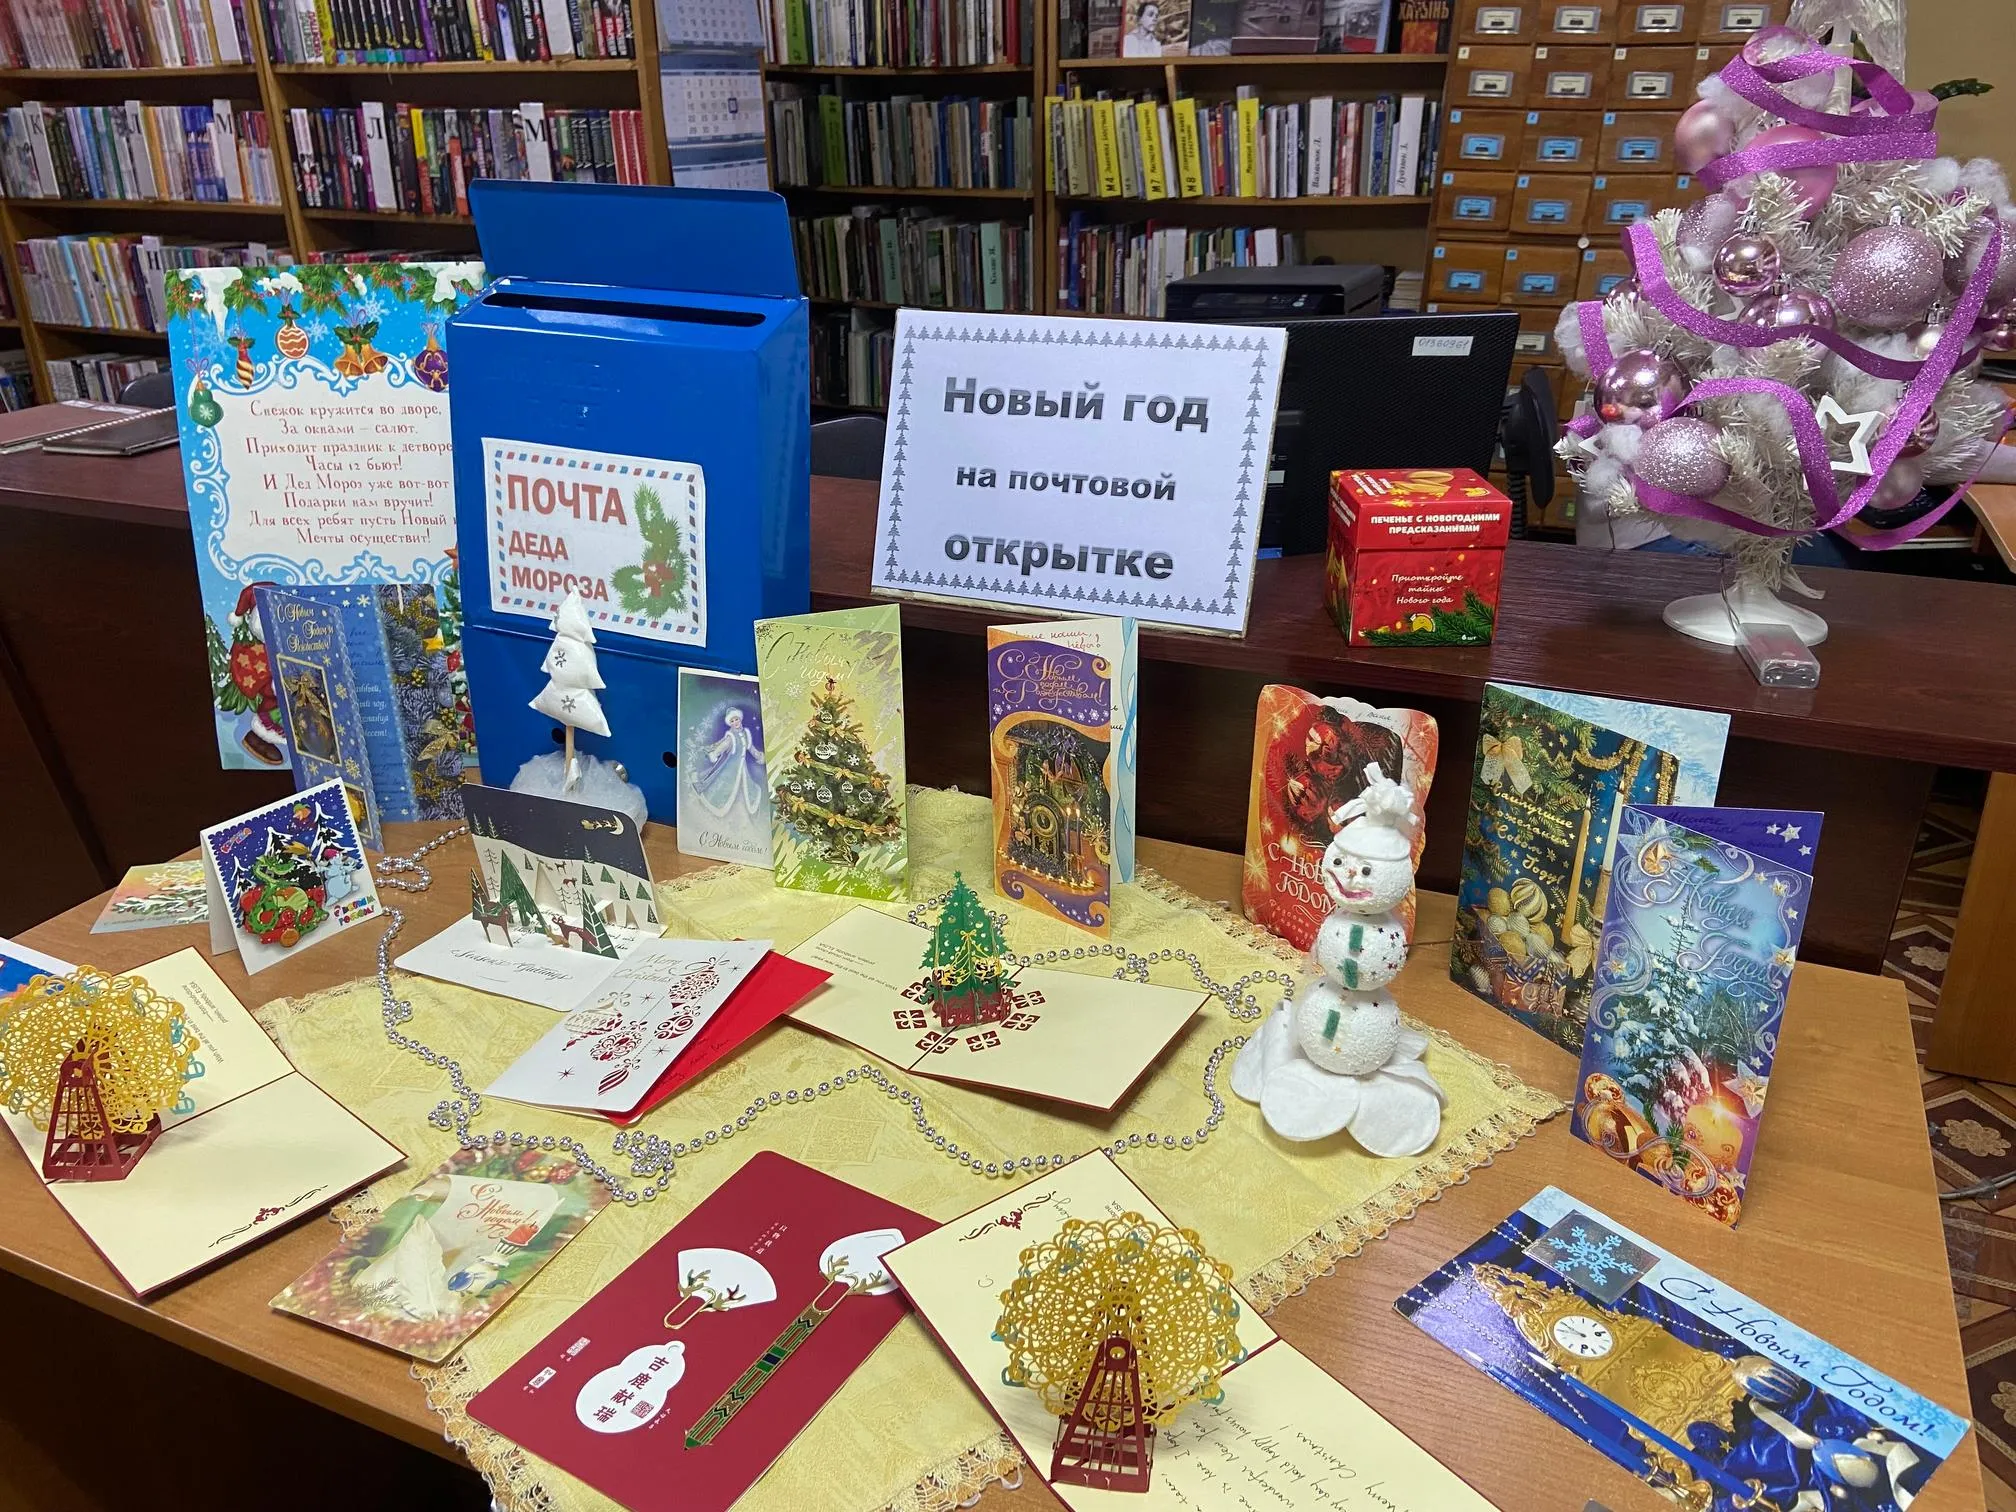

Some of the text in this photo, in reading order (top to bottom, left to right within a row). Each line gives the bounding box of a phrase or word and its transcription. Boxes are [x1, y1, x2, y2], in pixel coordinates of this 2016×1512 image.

[216, 113, 234, 137] М
[367, 118, 385, 141] Л
[525, 119, 547, 142] М
[310, 404, 374, 419] кружится
[380, 405, 395, 416] во
[943, 376, 1209, 433] Новый год
[280, 418, 298, 435] За
[304, 422, 355, 436] окнами
[246, 437, 317, 456] Приходит
[323, 441, 383, 459] праздник
[388, 444, 396, 452] к
[306, 454, 403, 472] Часы 12 бьют!
[263, 473, 450, 493] И Дед Мороз уже вот-вот
[956, 466, 1176, 501] на почтовой
[284, 492, 435, 511] Подарки нам вручит!
[507, 474, 627, 525] ПОЧТА
[249, 510, 447, 531] Для всех ребят пусть Новый
[1371, 513, 1501, 524] ПЕЧЕНЬЕ С НОВОГОДНИМИ
[297, 528, 432, 546] Мечты осуществит!
[1389, 524, 1480, 535] ПРЕДСКАЗАНИЯМИ
[508, 530, 568, 561] ДЕДА
[943, 534, 1175, 579] открытке
[511, 565, 609, 602] МОРОЗА
[1391, 574, 1464, 584] Приоткройте
[1408, 585, 1445, 593] тайны
[1396, 596, 1454, 605] Нового года
[699, 831, 710, 845] С
[710, 833, 741, 850] Новым
[1267, 843, 1280, 861] С
[470, 1183, 502, 1200] С
[1659, 1276, 1937, 1439] С Новым Годом!
[593, 1356, 670, 1423] 吉鹿献瑞
[1214, 1441, 1240, 1462] New
[1310, 1478, 1330, 1501] day
